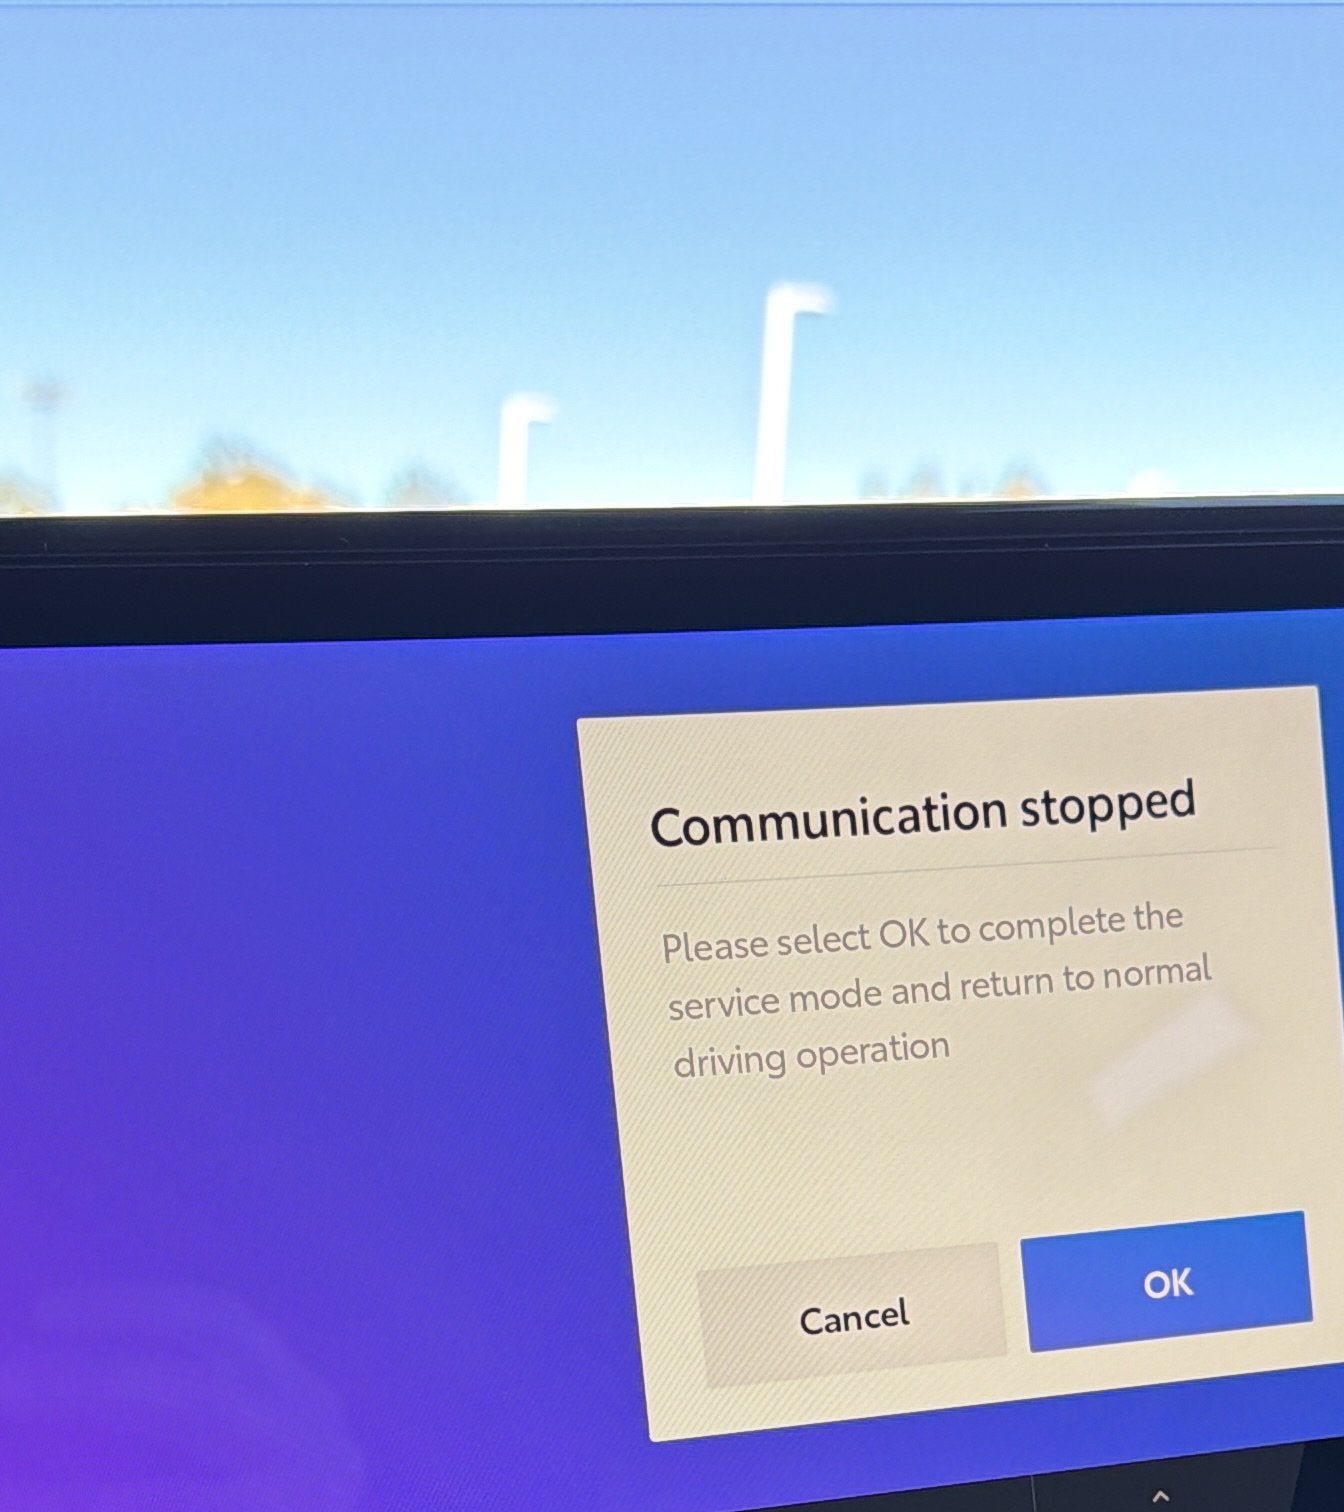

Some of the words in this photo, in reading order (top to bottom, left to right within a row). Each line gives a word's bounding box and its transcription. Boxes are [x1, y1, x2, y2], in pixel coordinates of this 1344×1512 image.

[651, 790, 1008, 848] Communication
[1020, 777, 1196, 833] stopped
[662, 931, 769, 964] Please
[777, 923, 872, 956] select
[879, 917, 931, 949] OK
[937, 918, 971, 945] to
[979, 905, 1126, 946] complete
[1133, 900, 1184, 931] the
[668, 987, 781, 1022] service
[789, 977, 883, 1013] mode
[891, 971, 952, 1005] and
[960, 970, 1054, 1001] return
[1063, 965, 1095, 992] to
[1103, 951, 1213, 990] normal
[673, 1044, 787, 1080] driving
[796, 1031, 951, 1076] operation
[1143, 1267, 1196, 1300] OK
[799, 1297, 912, 1338] Cancel
